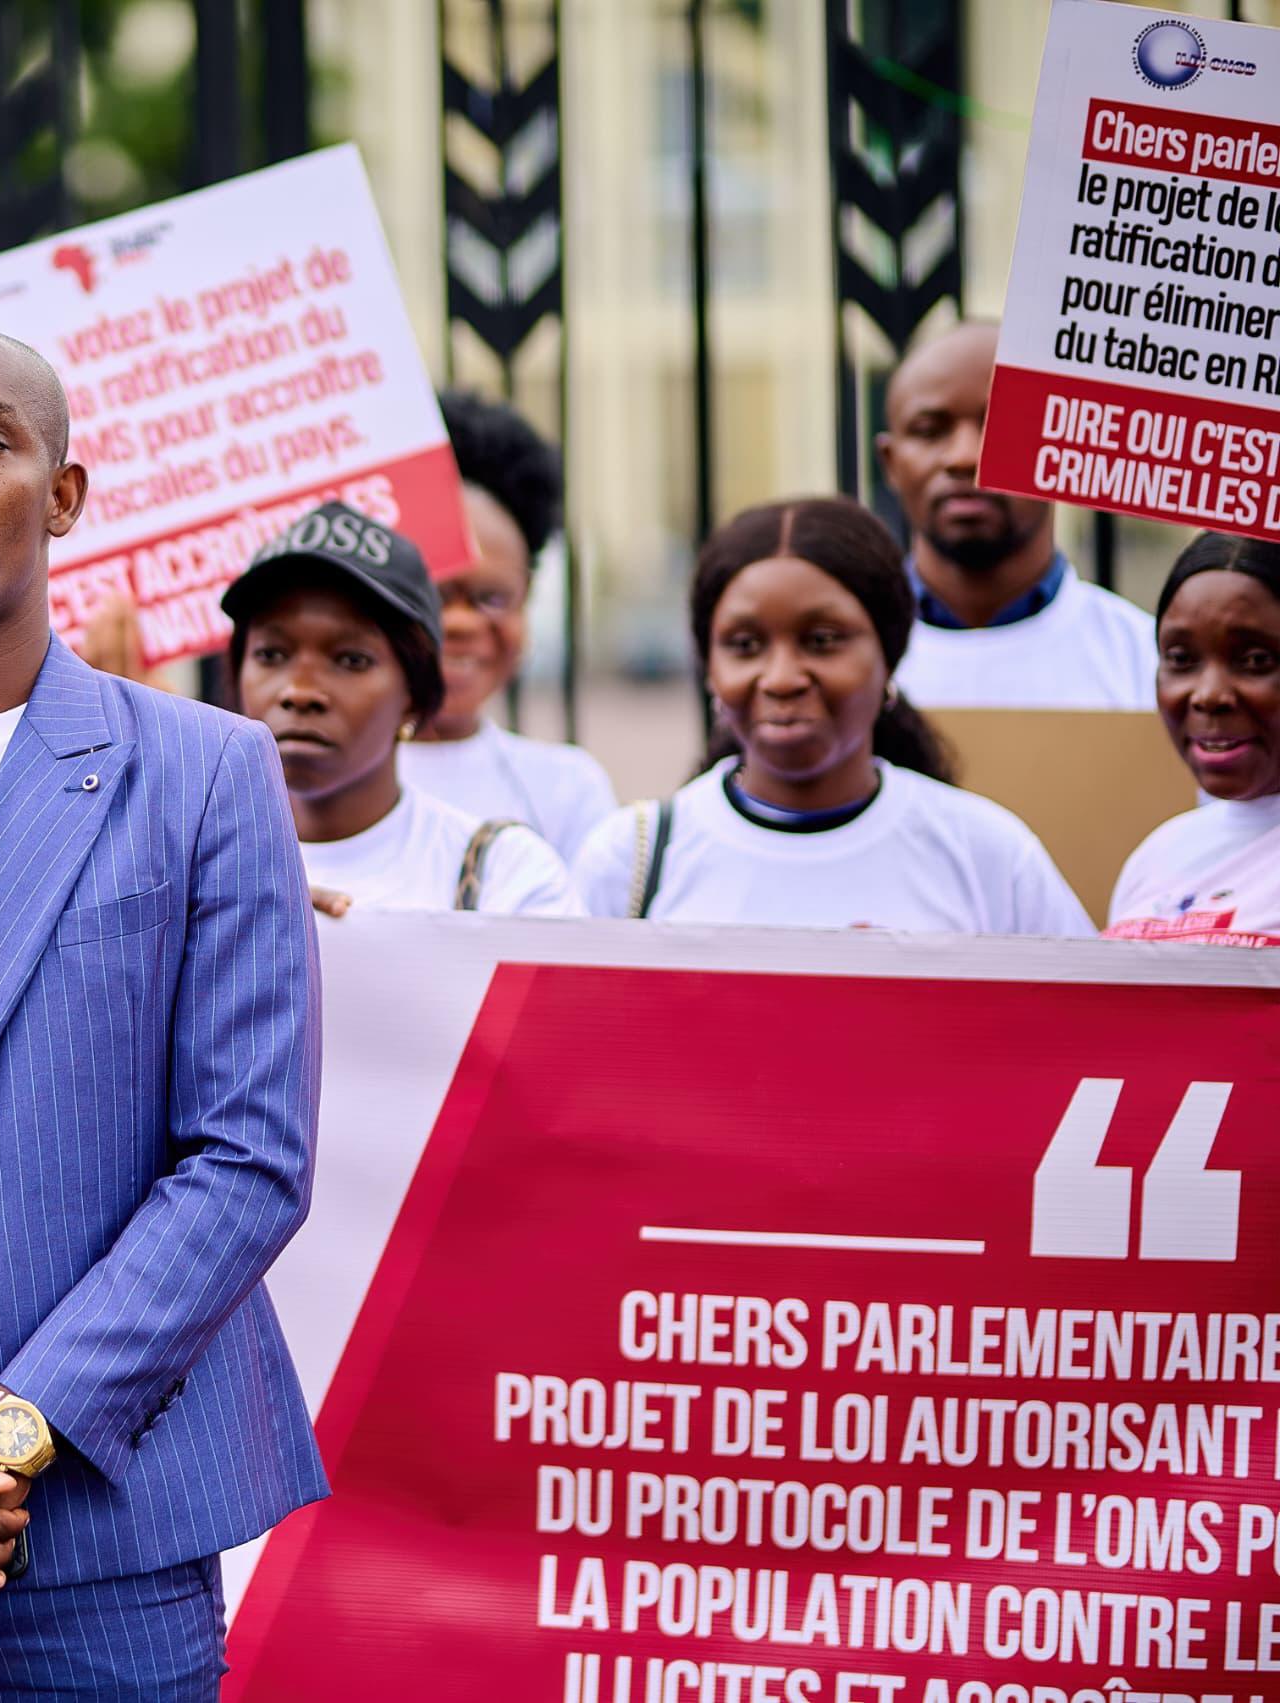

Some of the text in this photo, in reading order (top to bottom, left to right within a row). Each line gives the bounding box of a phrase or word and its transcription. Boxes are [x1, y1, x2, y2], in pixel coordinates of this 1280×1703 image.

[1092, 109, 1280, 178] Chers parle
[1077, 162, 1108, 205] le
[1111, 175, 1214, 226] projet
[1216, 185, 1260, 229] de
[1069, 218, 1257, 284] ratification
[58, 244, 352, 366] votez le projet de
[1060, 275, 1280, 340] pour éliminer
[101, 322, 297, 405] ratification
[299, 304, 348, 347] du
[1054, 321, 1280, 395] du tabac en R
[140, 402, 217, 458] pour
[223, 438, 270, 485] du
[1041, 394, 1280, 478] DIRE OUI C'EST
[1034, 444, 1263, 526] CRIMINELLES
[620, 1289, 1280, 1383] CHERS PARLEMENTAIRE
[494, 1371, 702, 1454] PROJET
[712, 1386, 788, 1459] DE
[800, 1390, 889, 1464] LOI
[899, 1395, 1264, 1479] AUTORISANT
[536, 1464, 1280, 1578] DU PROTOCOLE DE L'OMS P
[537, 1553, 611, 1632] LA
[621, 1559, 972, 1657] POPULATION
[983, 1583, 1211, 1671] CONTRE
